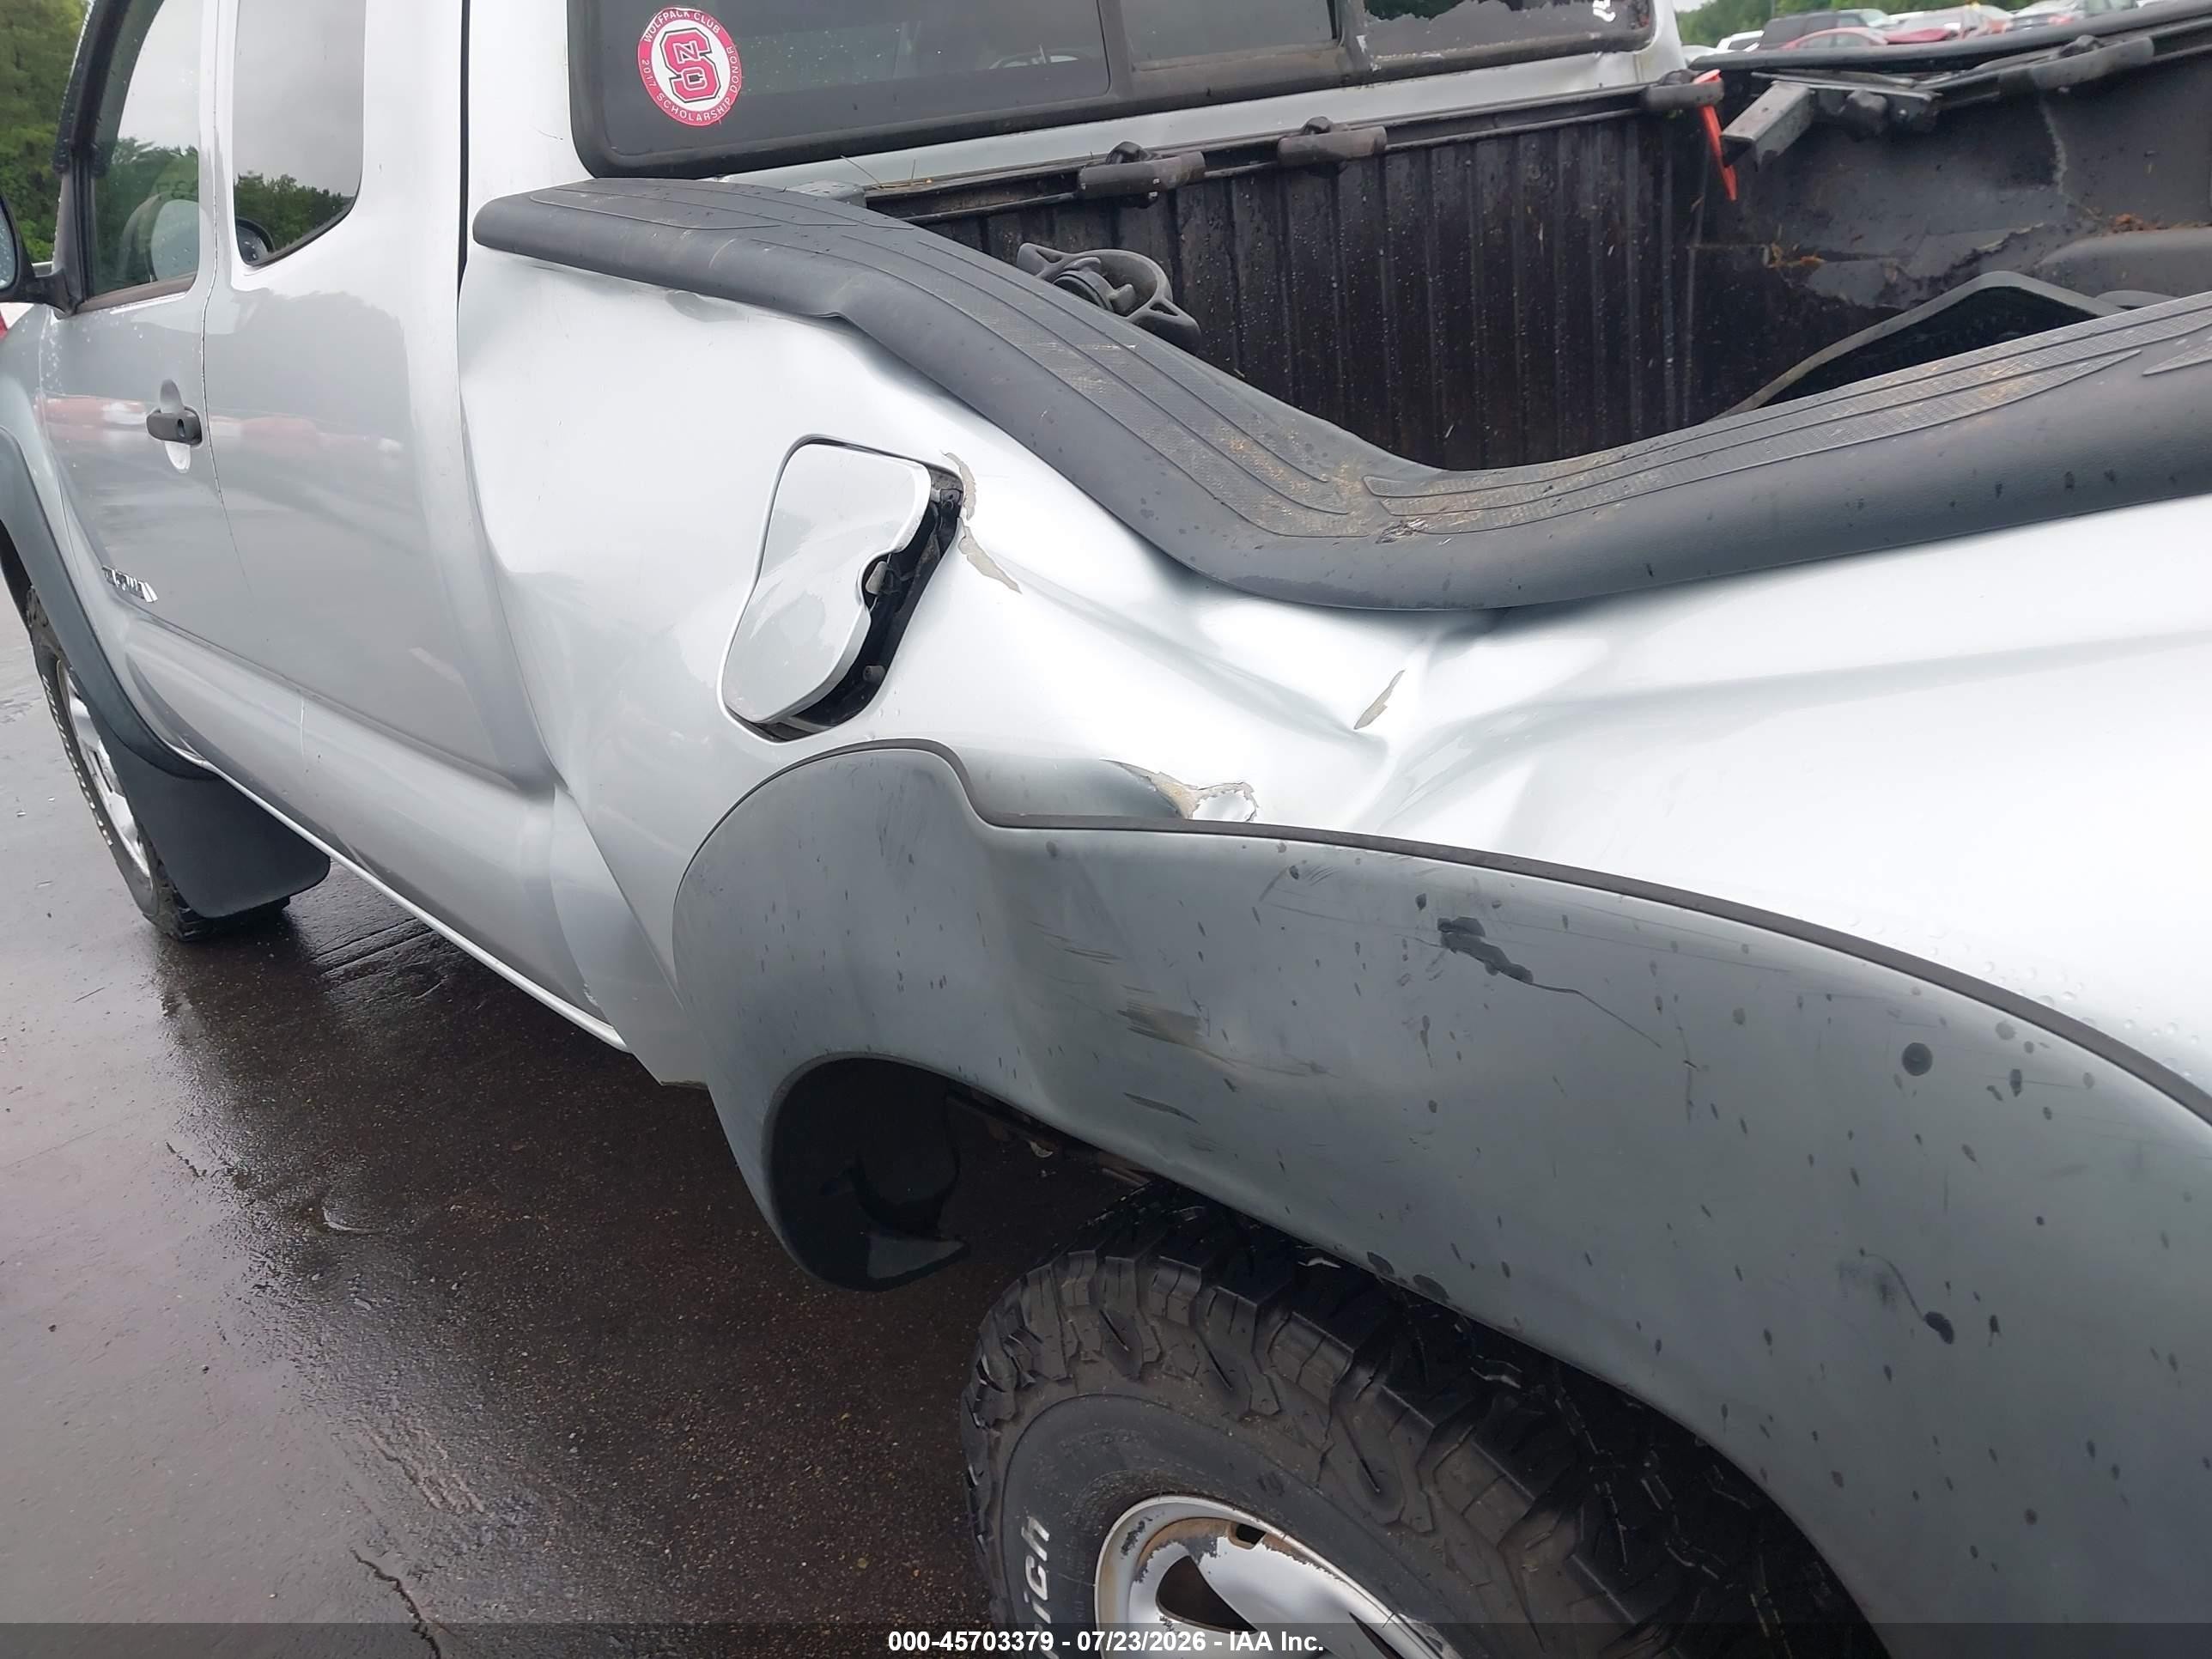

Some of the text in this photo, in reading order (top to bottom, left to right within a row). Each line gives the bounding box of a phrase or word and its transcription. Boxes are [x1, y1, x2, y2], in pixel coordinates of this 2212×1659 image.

[644, 9, 720, 43] WOLFPACK CLUB
[641, 46, 740, 123] 2017 SCHOLARSHIP DONOR
